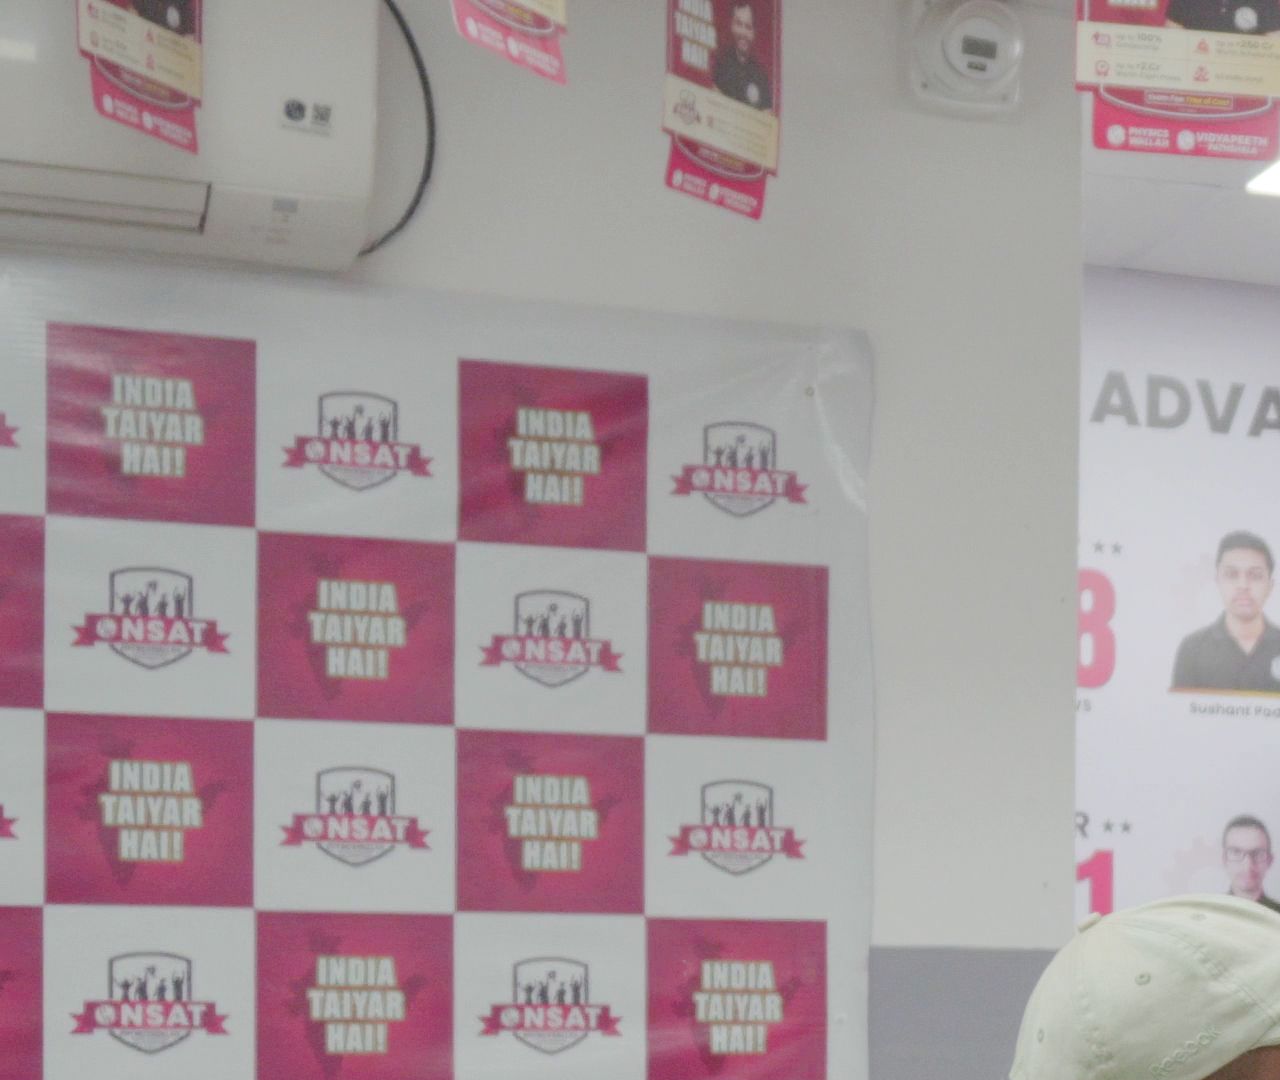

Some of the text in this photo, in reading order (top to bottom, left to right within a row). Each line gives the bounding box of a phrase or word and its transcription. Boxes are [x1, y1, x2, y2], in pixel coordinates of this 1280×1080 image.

[112, 374, 194, 407] INDIA
[103, 406, 204, 445] TAIYAR
[517, 406, 595, 439] INDIA
[121, 443, 186, 477] HAI!
[508, 438, 600, 475] TAIYAR
[525, 471, 584, 505] HAI!
[318, 579, 397, 612] INDIA
[308, 610, 406, 646] TAIYAR
[702, 602, 776, 633] INDIA
[327, 646, 388, 680] HAI!
[694, 632, 783, 666] TAIYAR
[710, 665, 767, 696] HAI!
[109, 760, 193, 792] INDIA
[513, 775, 591, 806] INDIA
[100, 792, 203, 827] TAIYAR
[505, 806, 598, 839] TAIYAR
[119, 826, 184, 862] HAI!
[522, 838, 581, 871] HAI!
[316, 956, 397, 987] INDIA
[702, 960, 776, 992] INDIA
[307, 986, 405, 1021] TAIYAR
[693, 991, 782, 1023] TAIYAR
[325, 1021, 388, 1054] HAI!
[710, 1023, 767, 1054] HAI!
